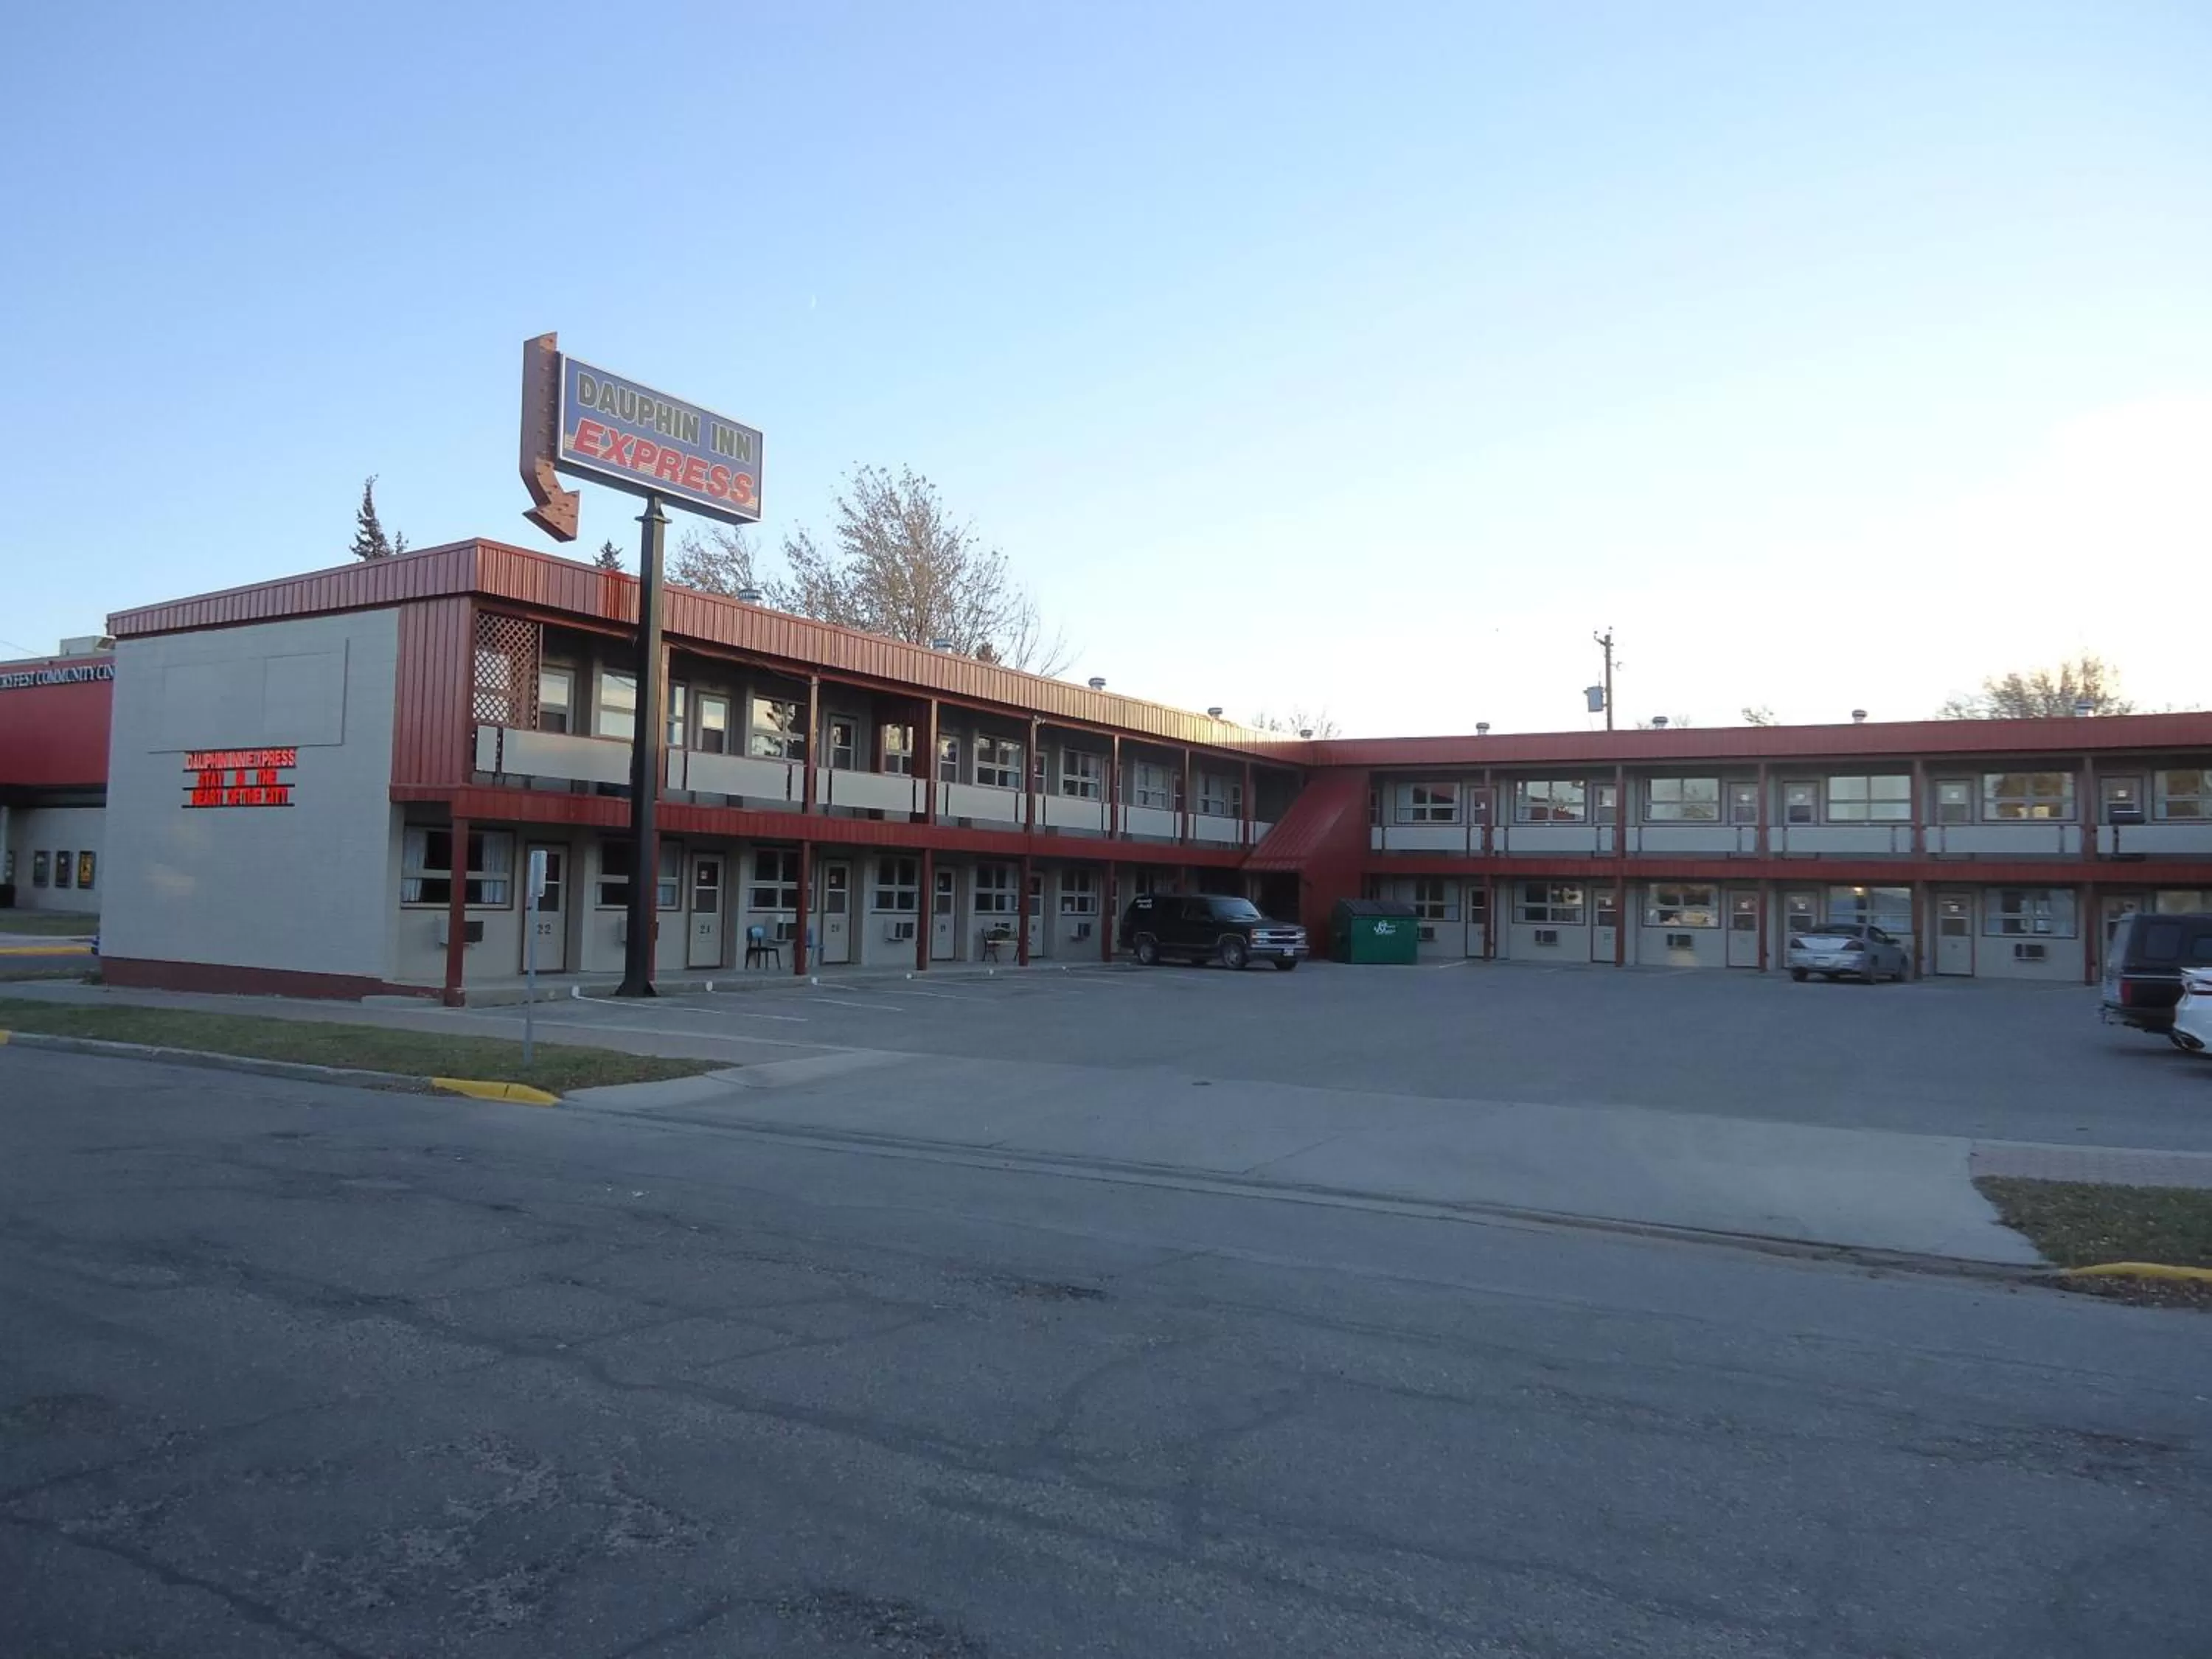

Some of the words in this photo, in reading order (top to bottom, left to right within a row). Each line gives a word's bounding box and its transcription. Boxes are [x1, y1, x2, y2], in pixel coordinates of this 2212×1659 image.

[578, 371, 700, 447] DAUPHIN
[710, 421, 753, 465] INN
[573, 417, 755, 506] EXPRESS
[36, 665, 96, 685] COMMUNITY
[186, 752, 228, 769] DAUPHIN
[246, 748, 296, 767] EXPRESS
